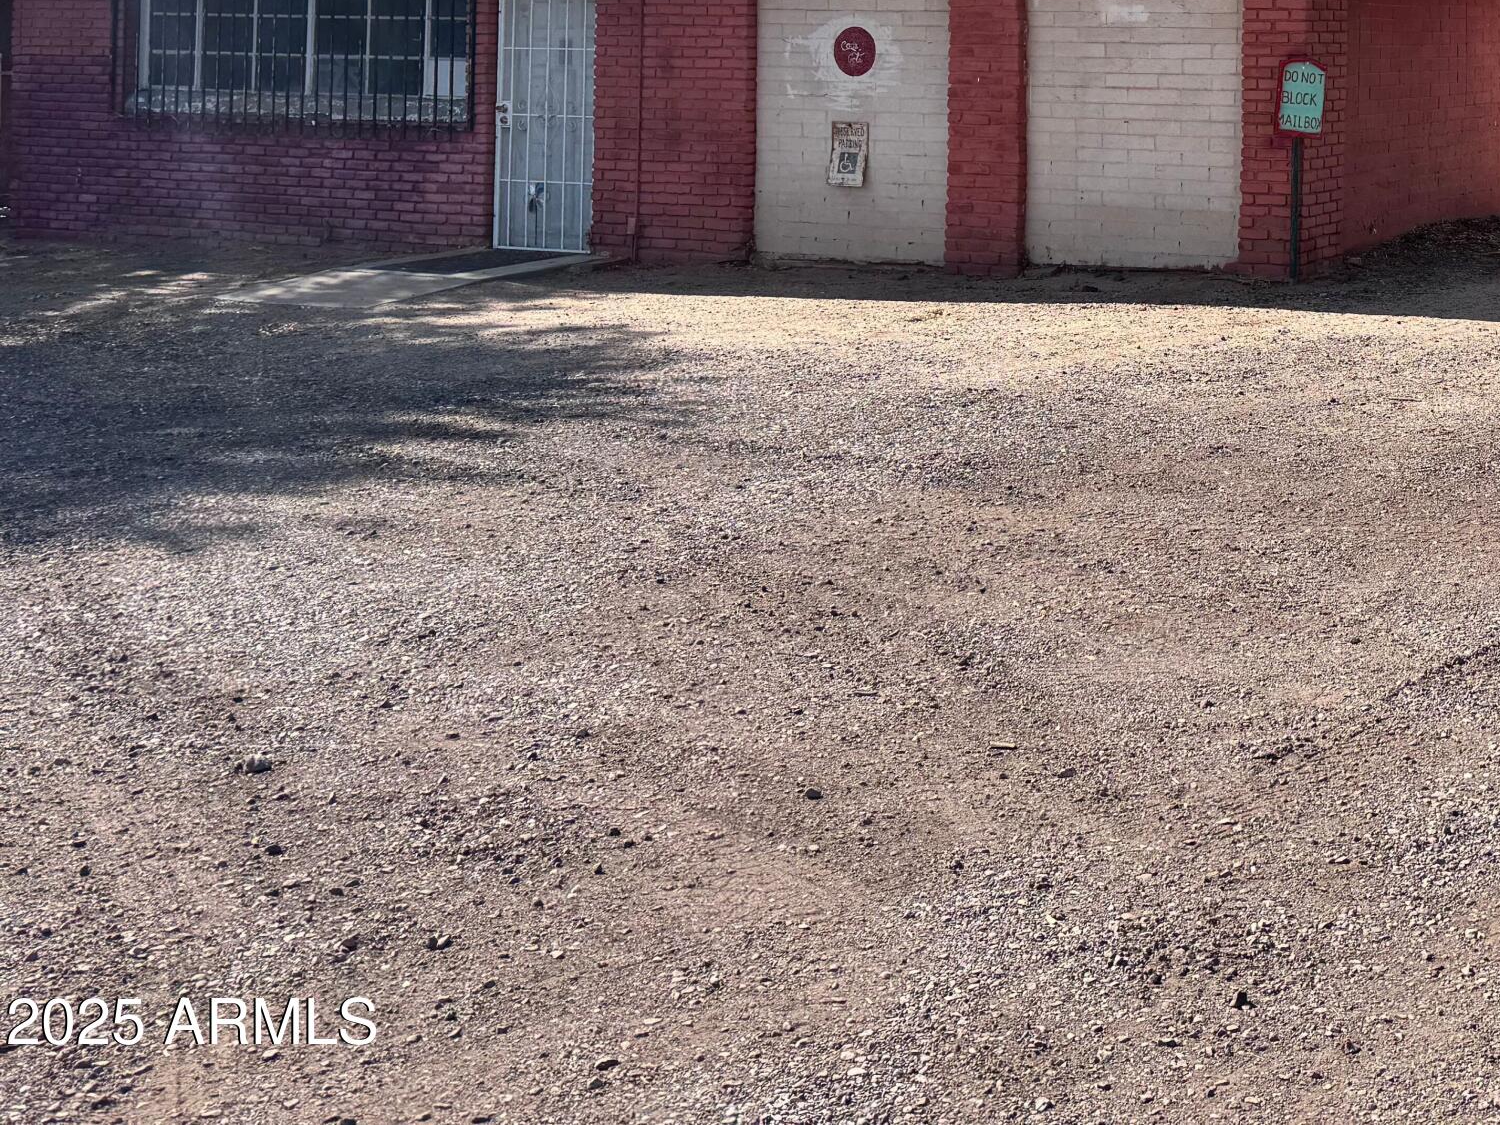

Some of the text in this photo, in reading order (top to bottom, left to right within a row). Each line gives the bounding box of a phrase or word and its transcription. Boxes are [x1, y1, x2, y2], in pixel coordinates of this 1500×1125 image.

[1284, 70, 1325, 85] DO NOT
[1281, 91, 1317, 106] BLOCK
